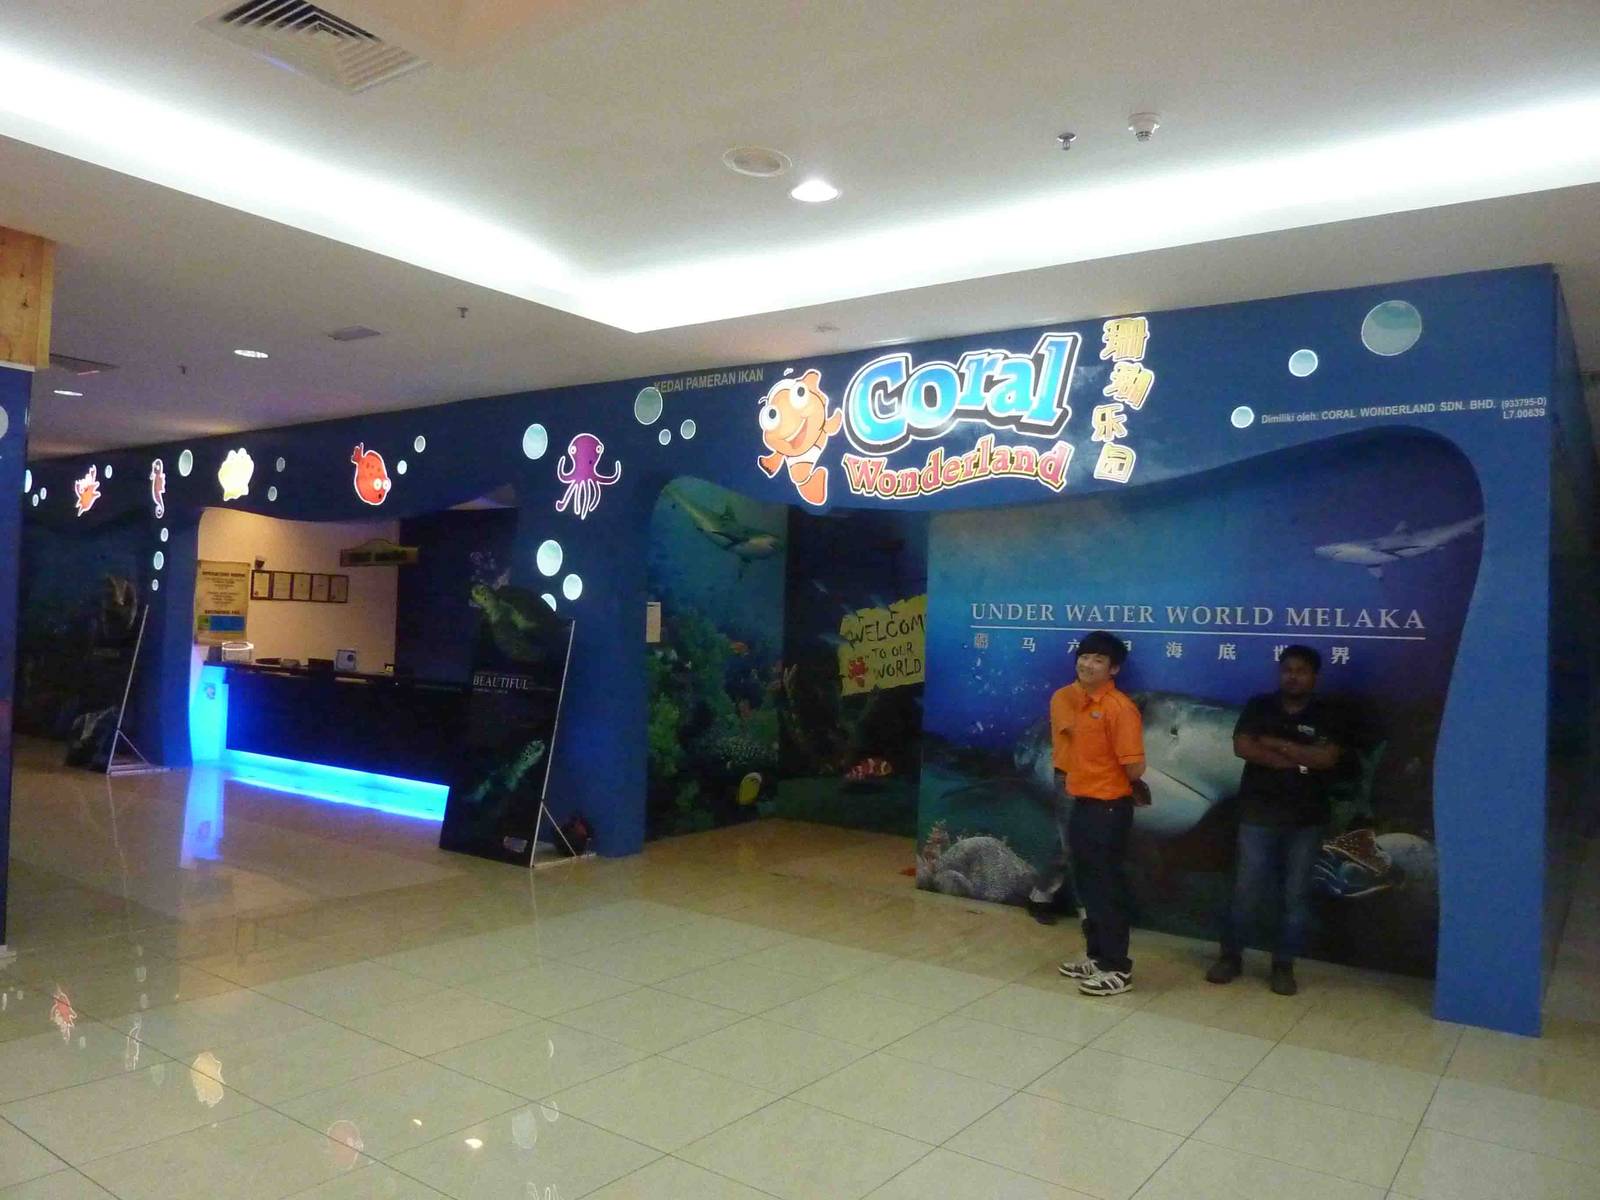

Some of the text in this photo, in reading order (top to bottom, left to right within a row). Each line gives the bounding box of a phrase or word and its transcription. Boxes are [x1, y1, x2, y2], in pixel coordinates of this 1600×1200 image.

[654, 368, 764, 393] KEDAI PAMERAN IKAN
[844, 333, 1081, 455] Coral
[1321, 408, 1357, 420] CORAL
[1360, 403, 1435, 417] WONDERLAND
[1440, 400, 1466, 412] SDN.
[1470, 399, 1496, 410] BHD.
[841, 434, 1075, 499] Wonderland
[971, 603, 1425, 629] UNDER WATER WORLD MELAKA
[848, 613, 927, 649] WELCOM
[872, 648, 887, 659] TO
[875, 658, 922, 679] WORLD
[473, 675, 529, 690] BEAUTIFUL
